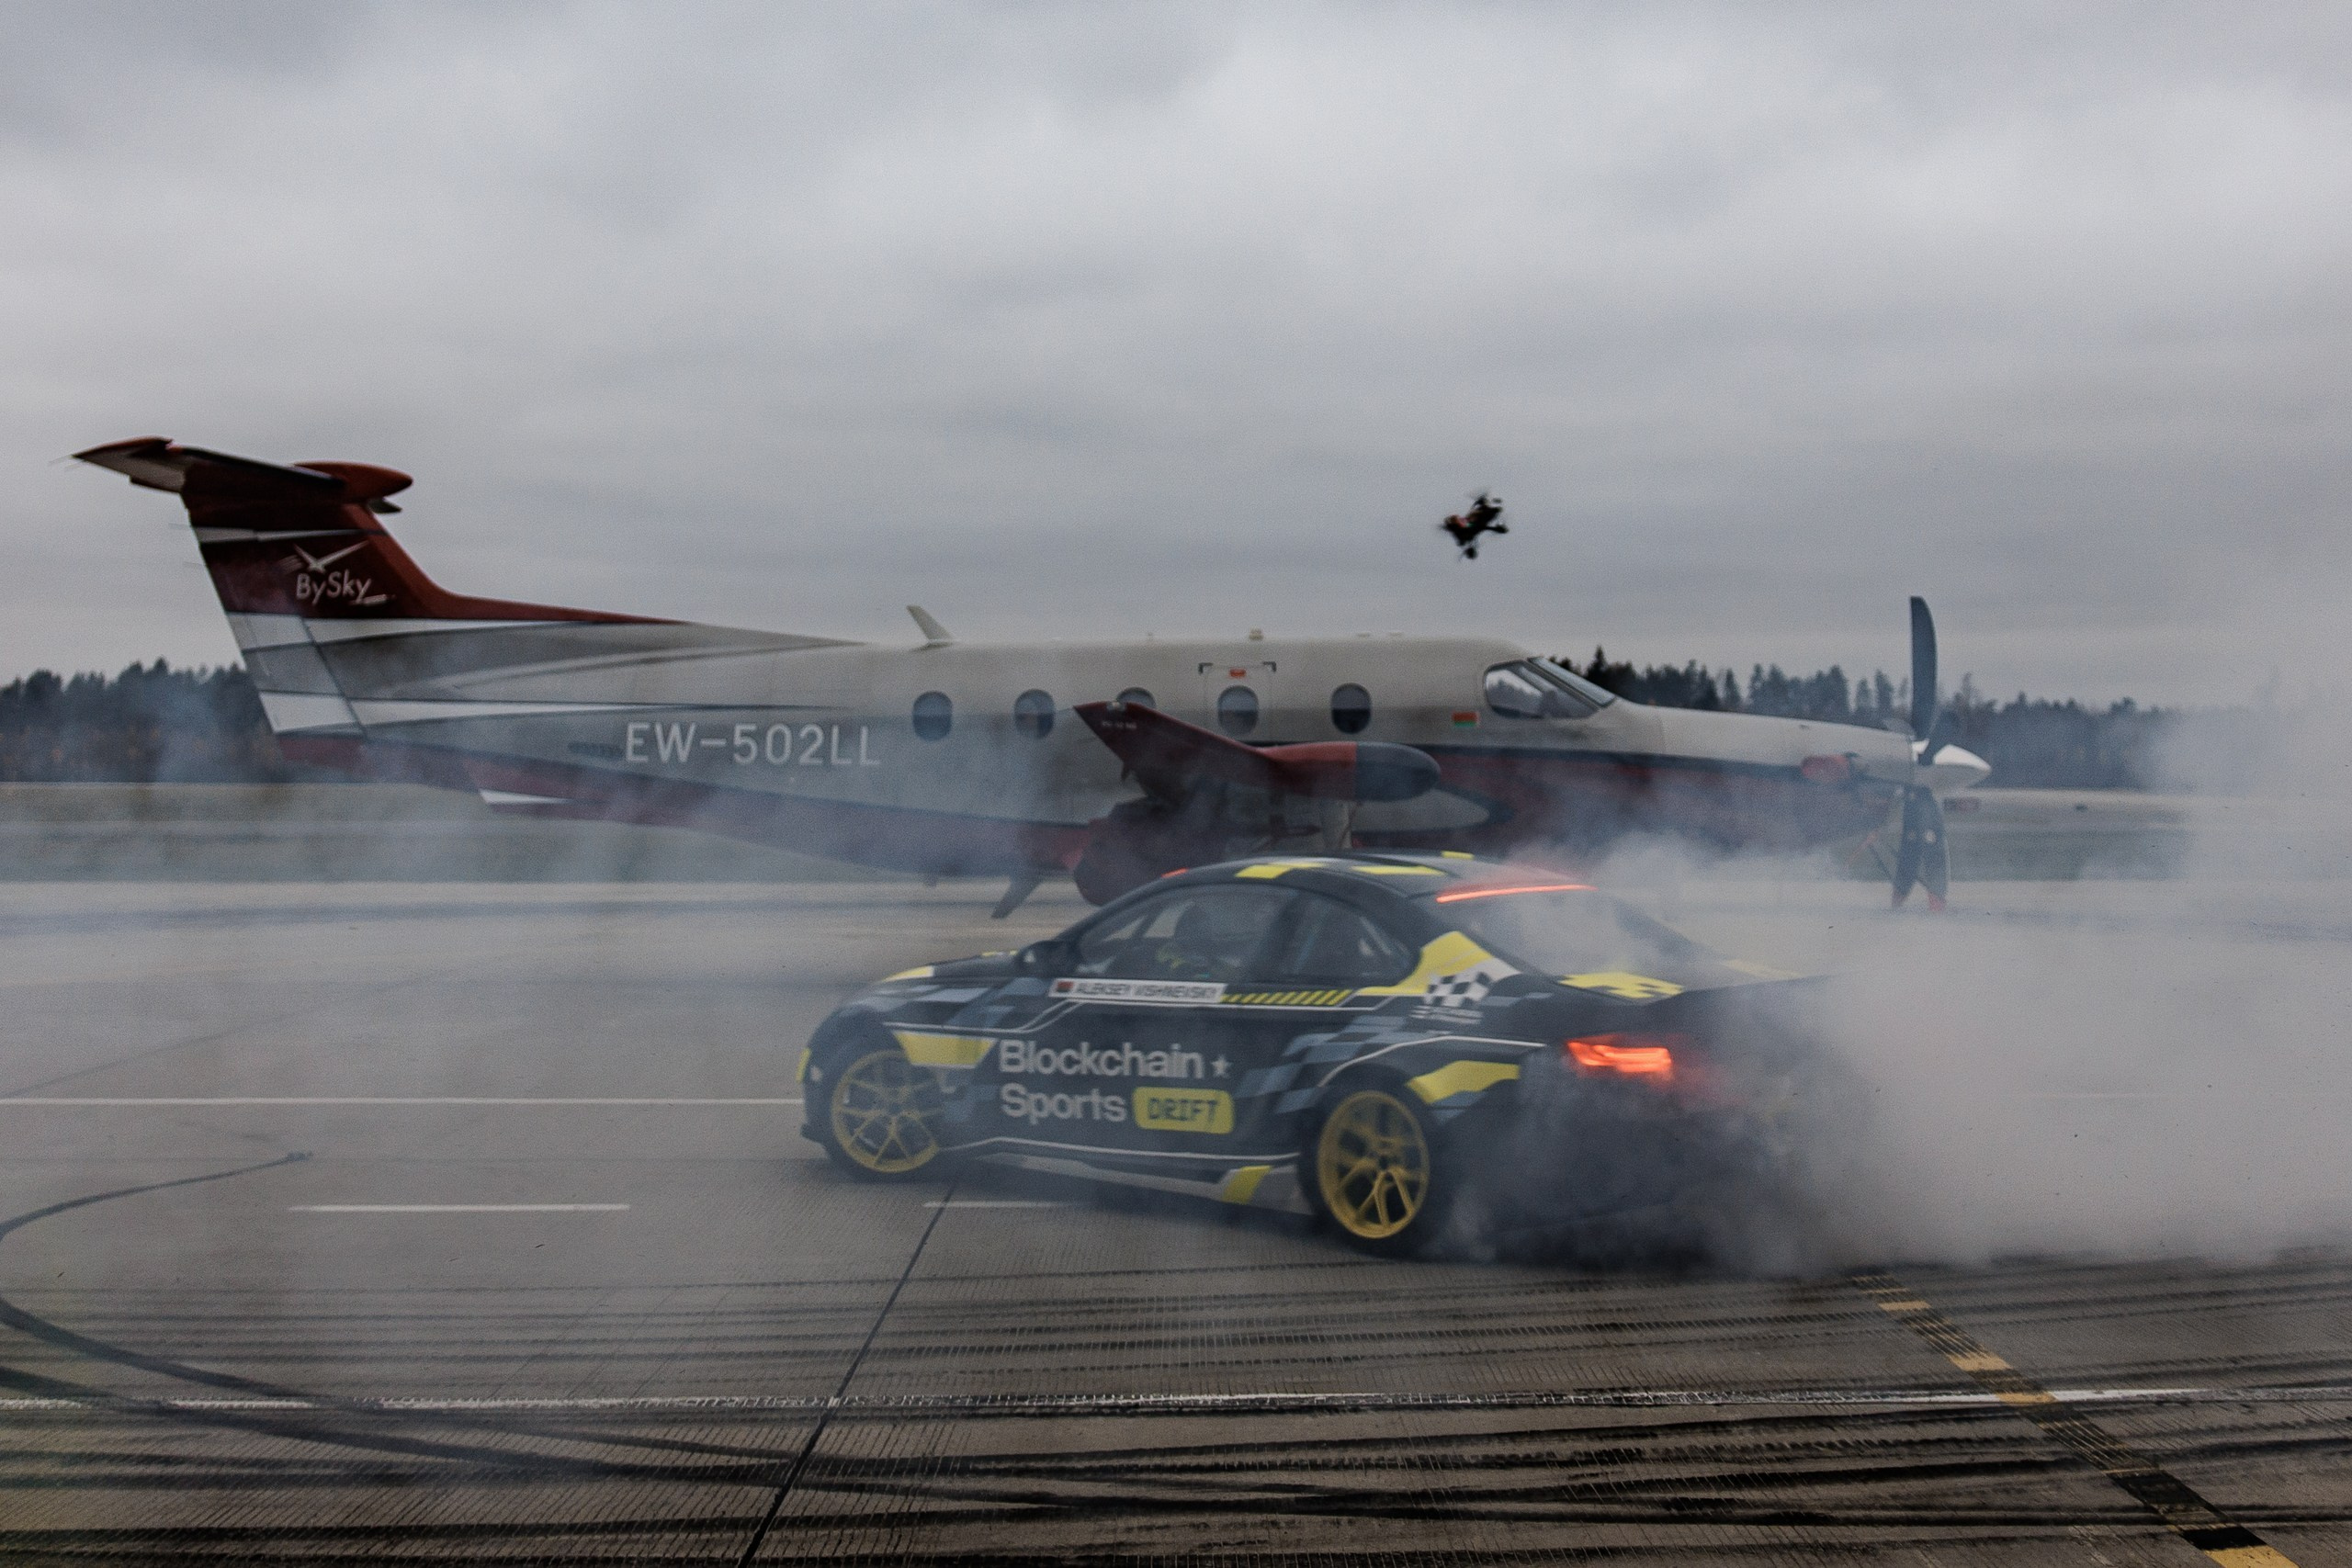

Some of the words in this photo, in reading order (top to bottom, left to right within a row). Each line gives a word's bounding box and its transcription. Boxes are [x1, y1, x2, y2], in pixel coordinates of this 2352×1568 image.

[296, 569, 372, 604] BySky
[626, 721, 881, 765] EW-502LL
[999, 1039, 1205, 1078] Blockchain
[1000, 1082, 1127, 1125] Sports
[1148, 1097, 1219, 1123] DRIFT
